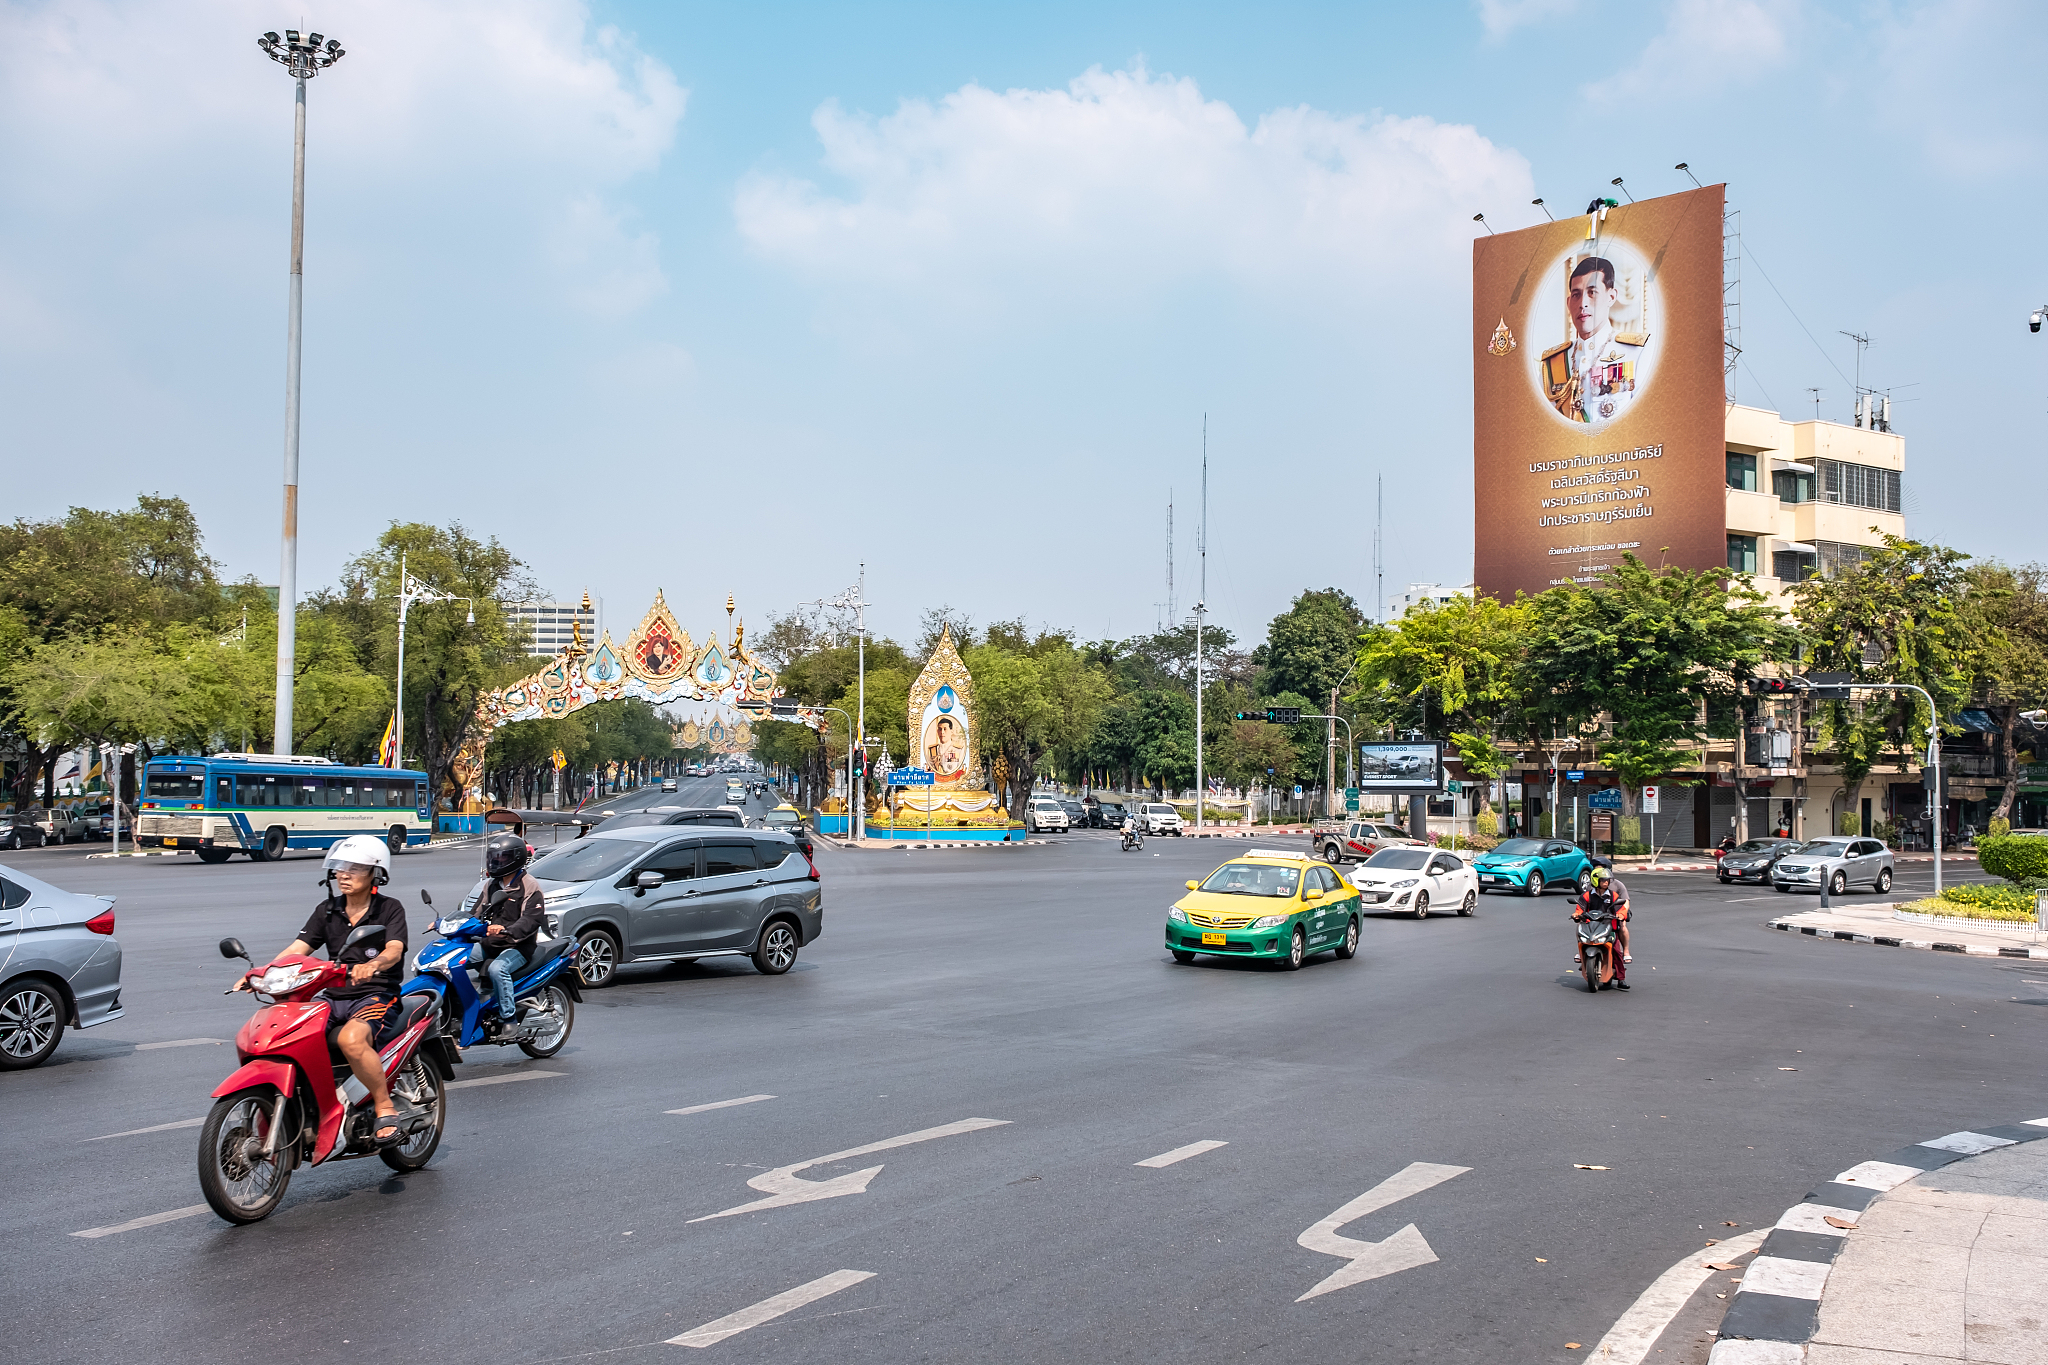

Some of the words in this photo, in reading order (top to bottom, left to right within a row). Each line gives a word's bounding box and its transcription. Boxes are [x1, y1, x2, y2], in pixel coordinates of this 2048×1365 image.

[1529, 444, 1663, 473] บรมราชาภิเษกบรมกษัตริย์
[1550, 467, 1639, 489] เฉลิมสวัสดิ์รัฐสีมา
[1541, 485, 1650, 508] พระบารมีเกริกก้องฟ้า
[1539, 503, 1652, 527] ปกประชาราษฎร์ร่มเย็น
